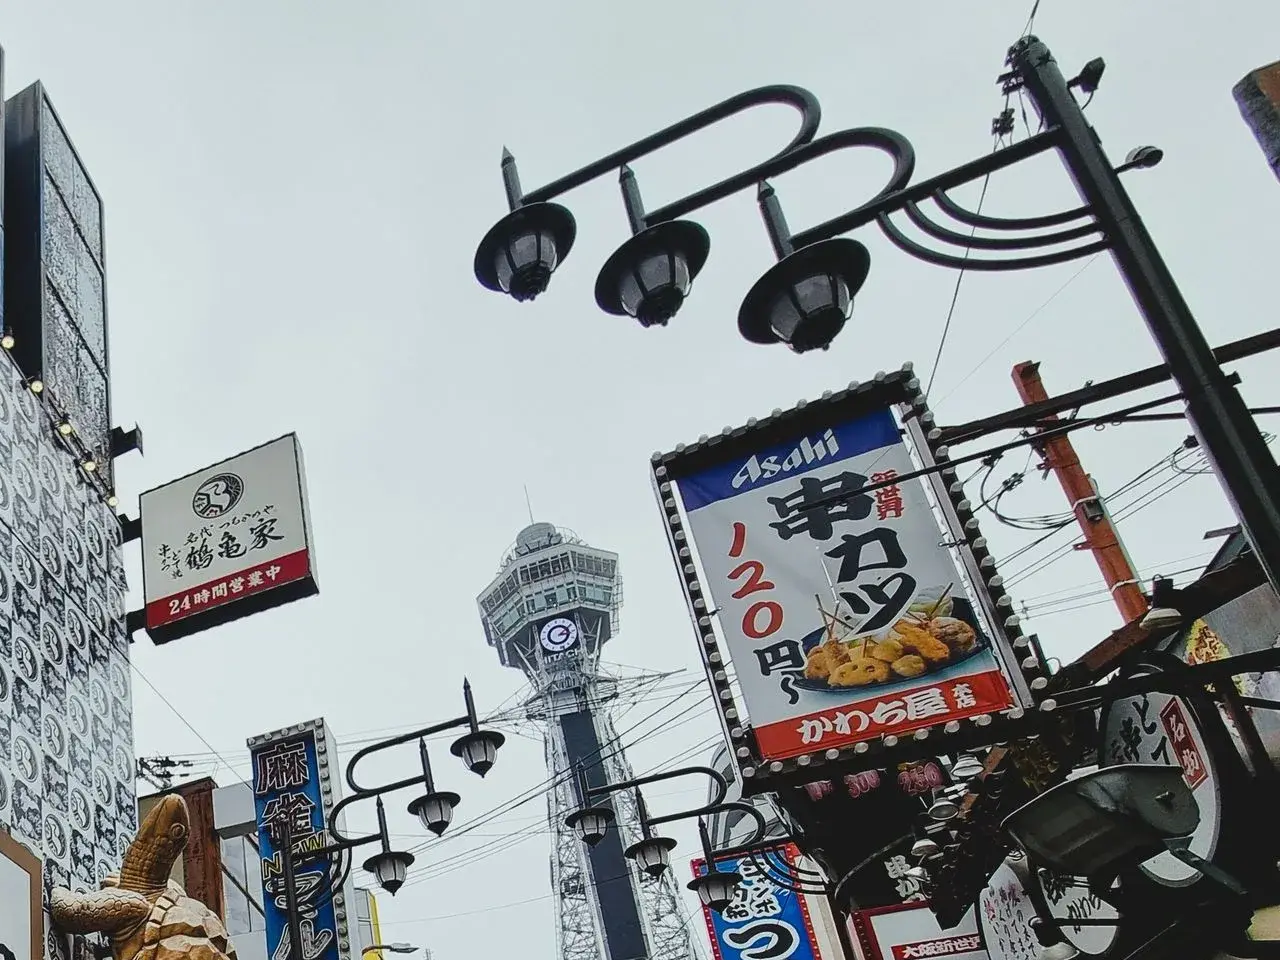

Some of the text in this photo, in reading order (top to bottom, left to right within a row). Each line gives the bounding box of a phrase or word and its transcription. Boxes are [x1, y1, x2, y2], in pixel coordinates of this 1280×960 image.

[731, 428, 841, 490] Asahi
[766, 471, 918, 636] 串カツ
[168, 565, 282, 616] 24時間営業中
[796, 688, 952, 745] かわち屋
[255, 739, 316, 840] 麻雀
